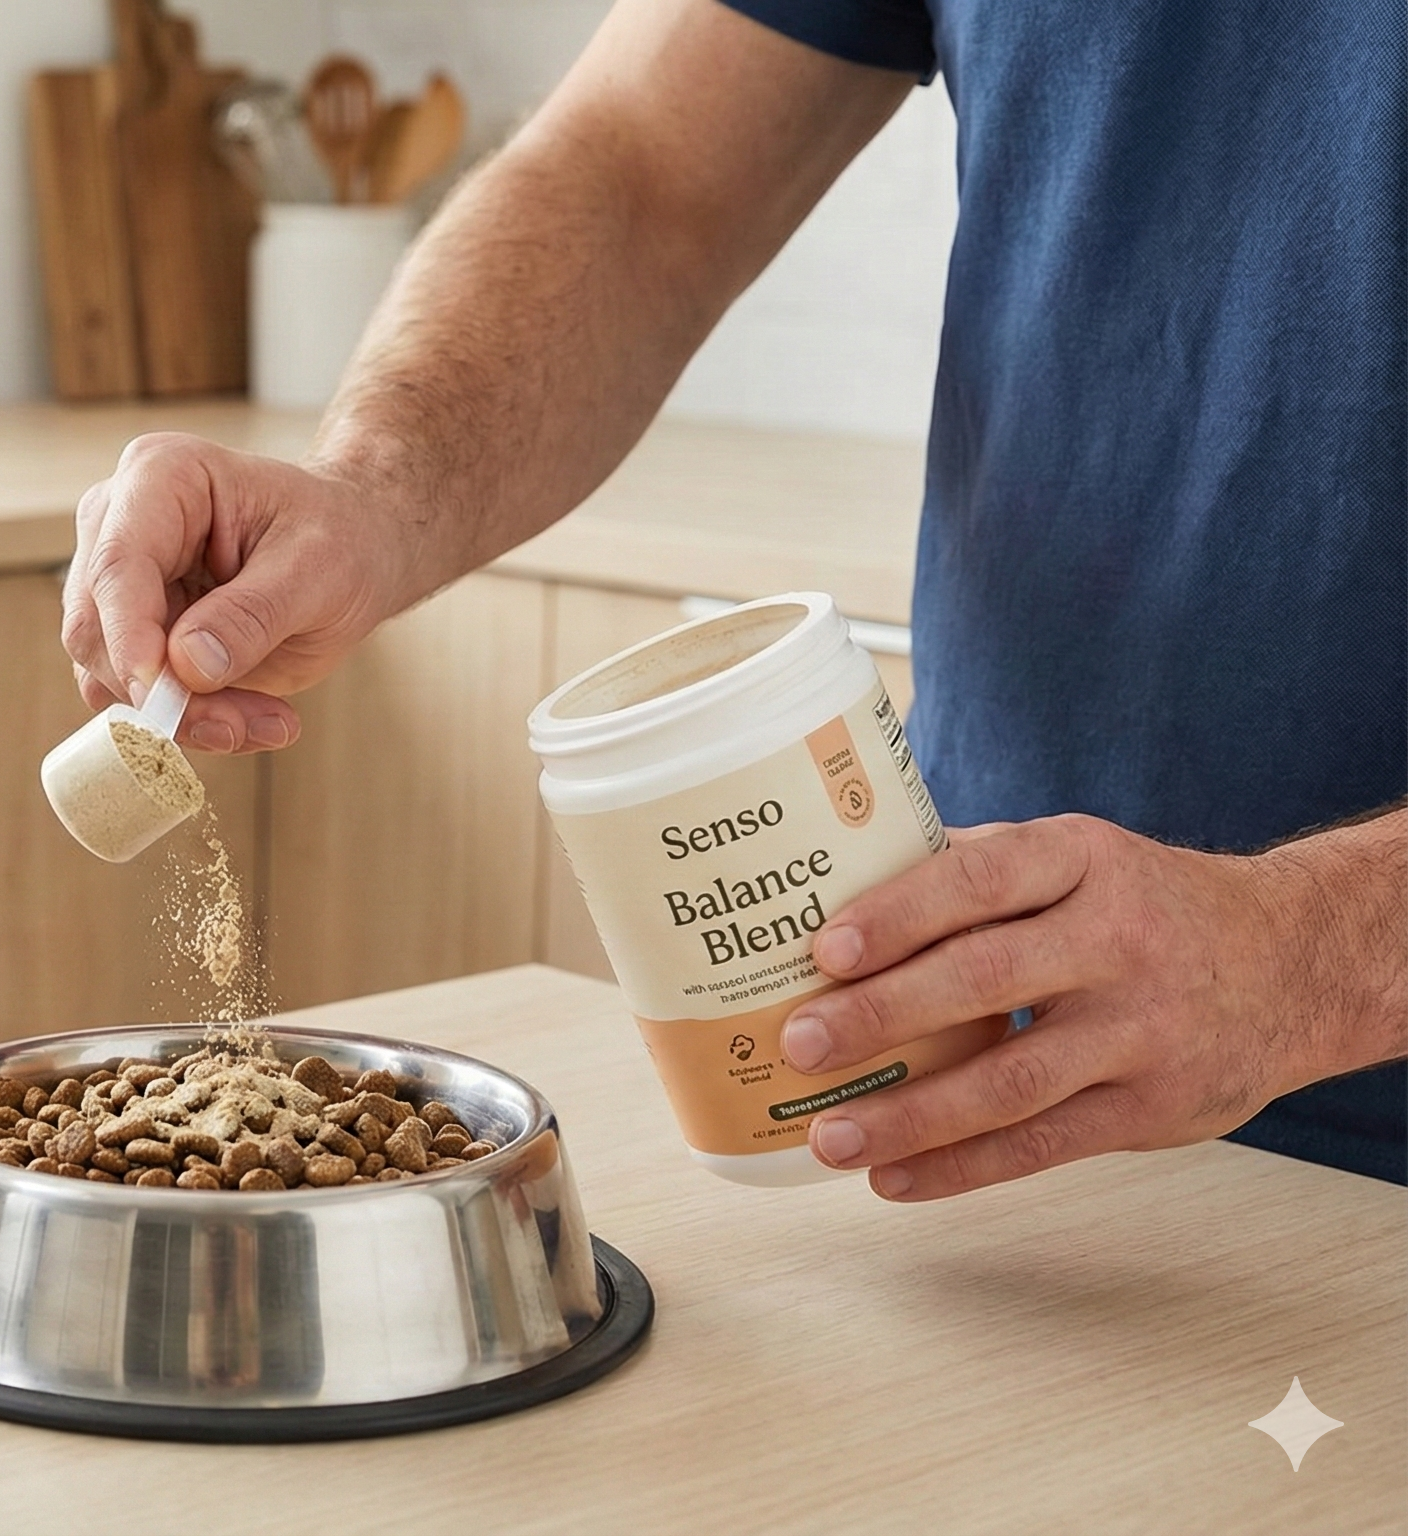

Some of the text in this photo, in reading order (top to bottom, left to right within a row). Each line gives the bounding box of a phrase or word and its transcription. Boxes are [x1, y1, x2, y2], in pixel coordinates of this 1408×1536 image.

[661, 800, 784, 860] Senso
[663, 849, 833, 926] Balance
[700, 891, 827, 966] Blend
